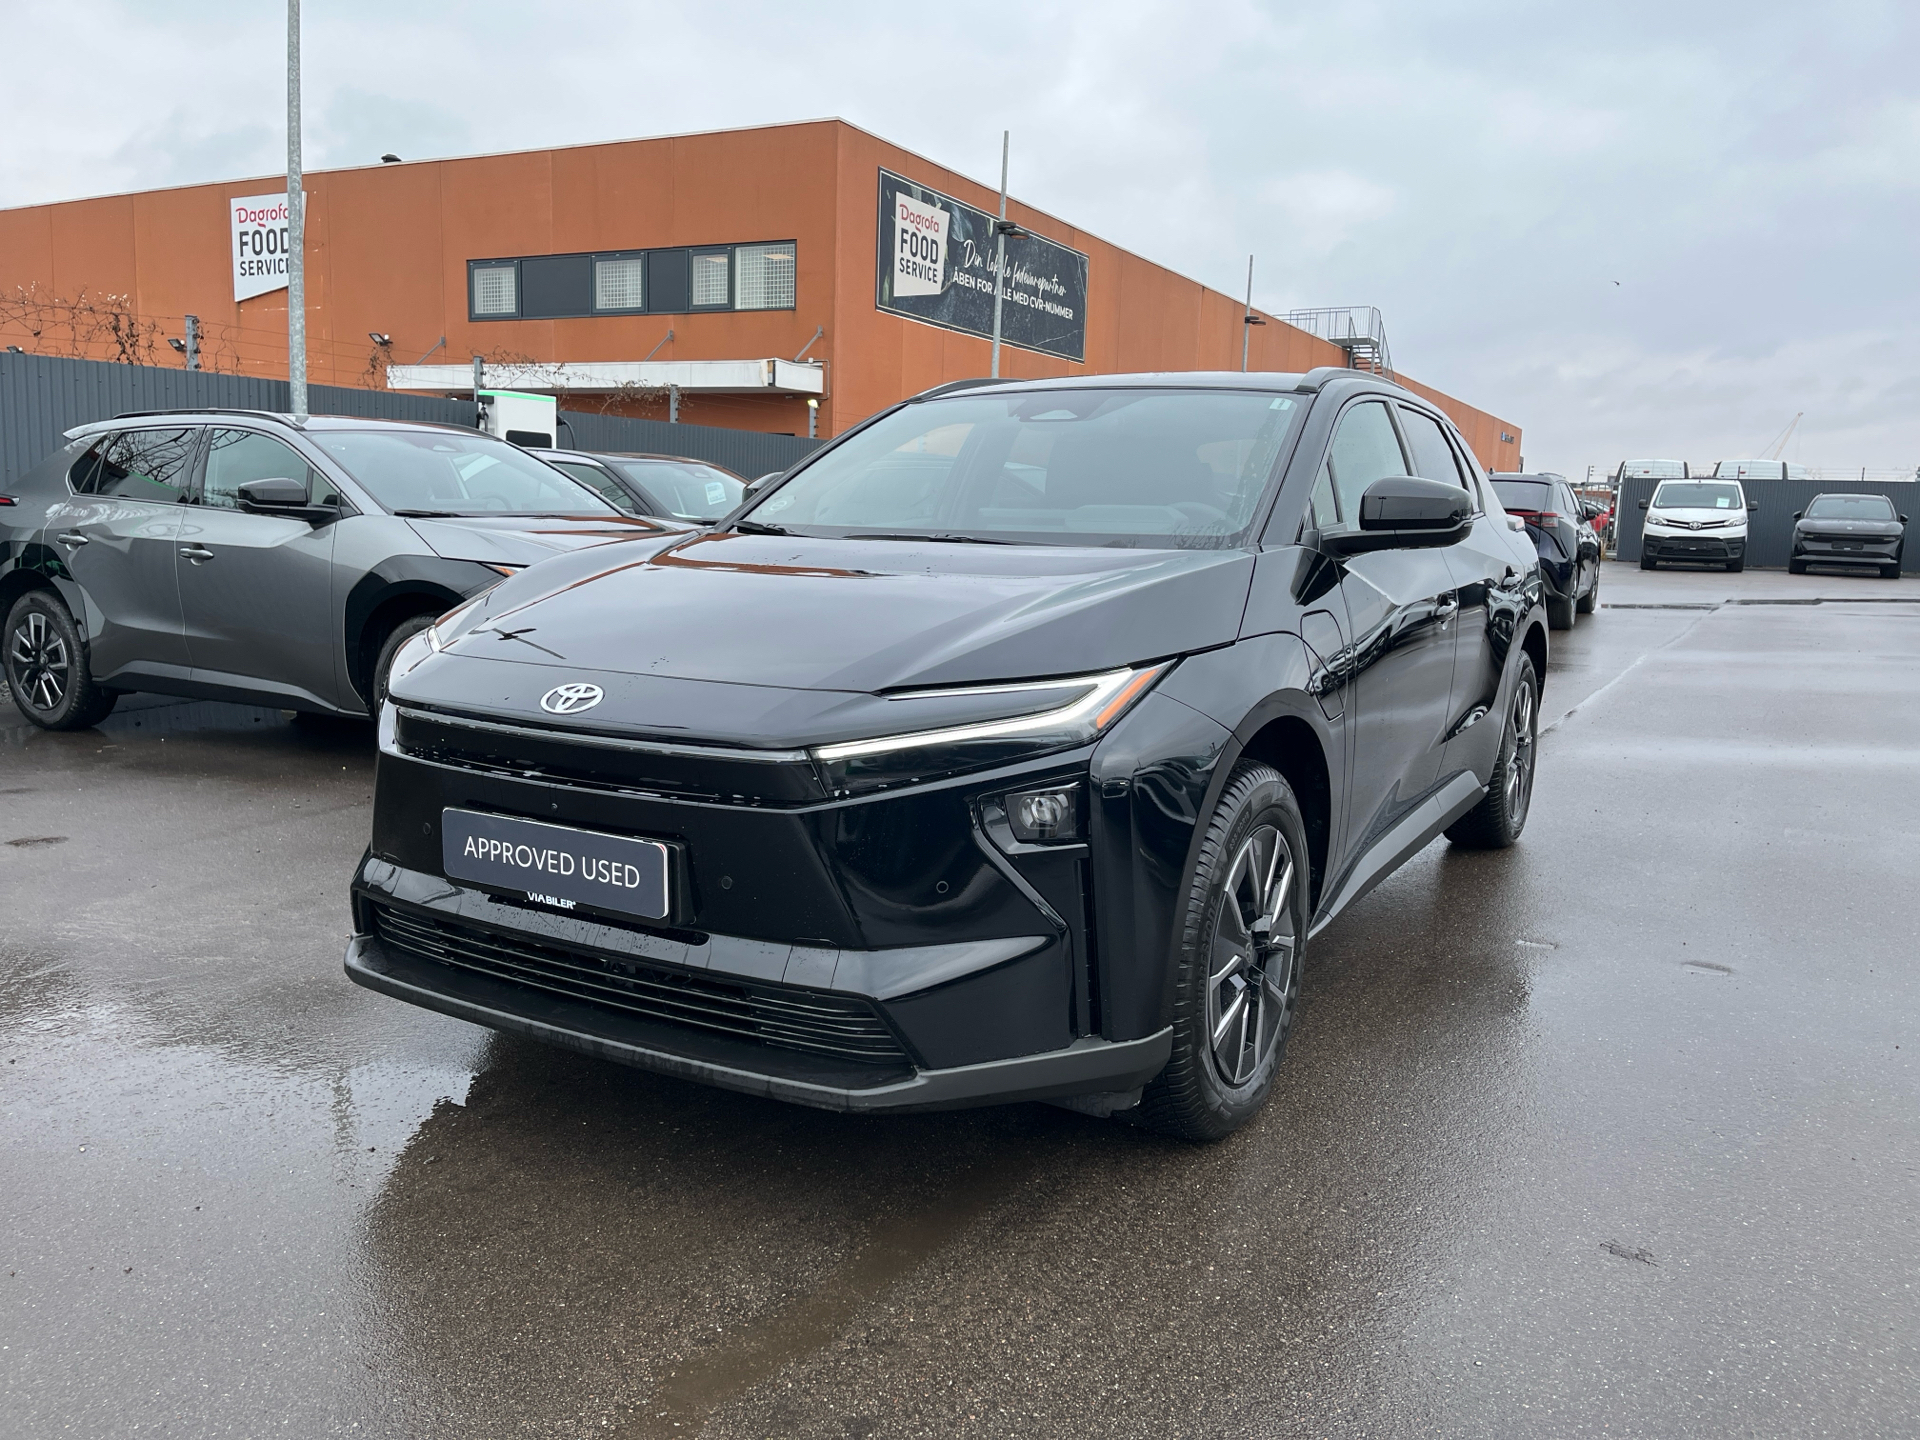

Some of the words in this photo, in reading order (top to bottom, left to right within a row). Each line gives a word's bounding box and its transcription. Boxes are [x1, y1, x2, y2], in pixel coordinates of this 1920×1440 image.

[900, 203, 940, 233] Dagrofa
[901, 227, 939, 265] FOOD
[964, 239, 983, 268] Din
[899, 257, 938, 284] SERVICE
[952, 266, 976, 289] ÅBEN
[977, 278, 993, 295] FOR
[1012, 290, 1029, 305] MED
[1029, 296, 1073, 320] CVR-NUMMER
[464, 835, 575, 875] APPROVED
[582, 856, 640, 888] USED
